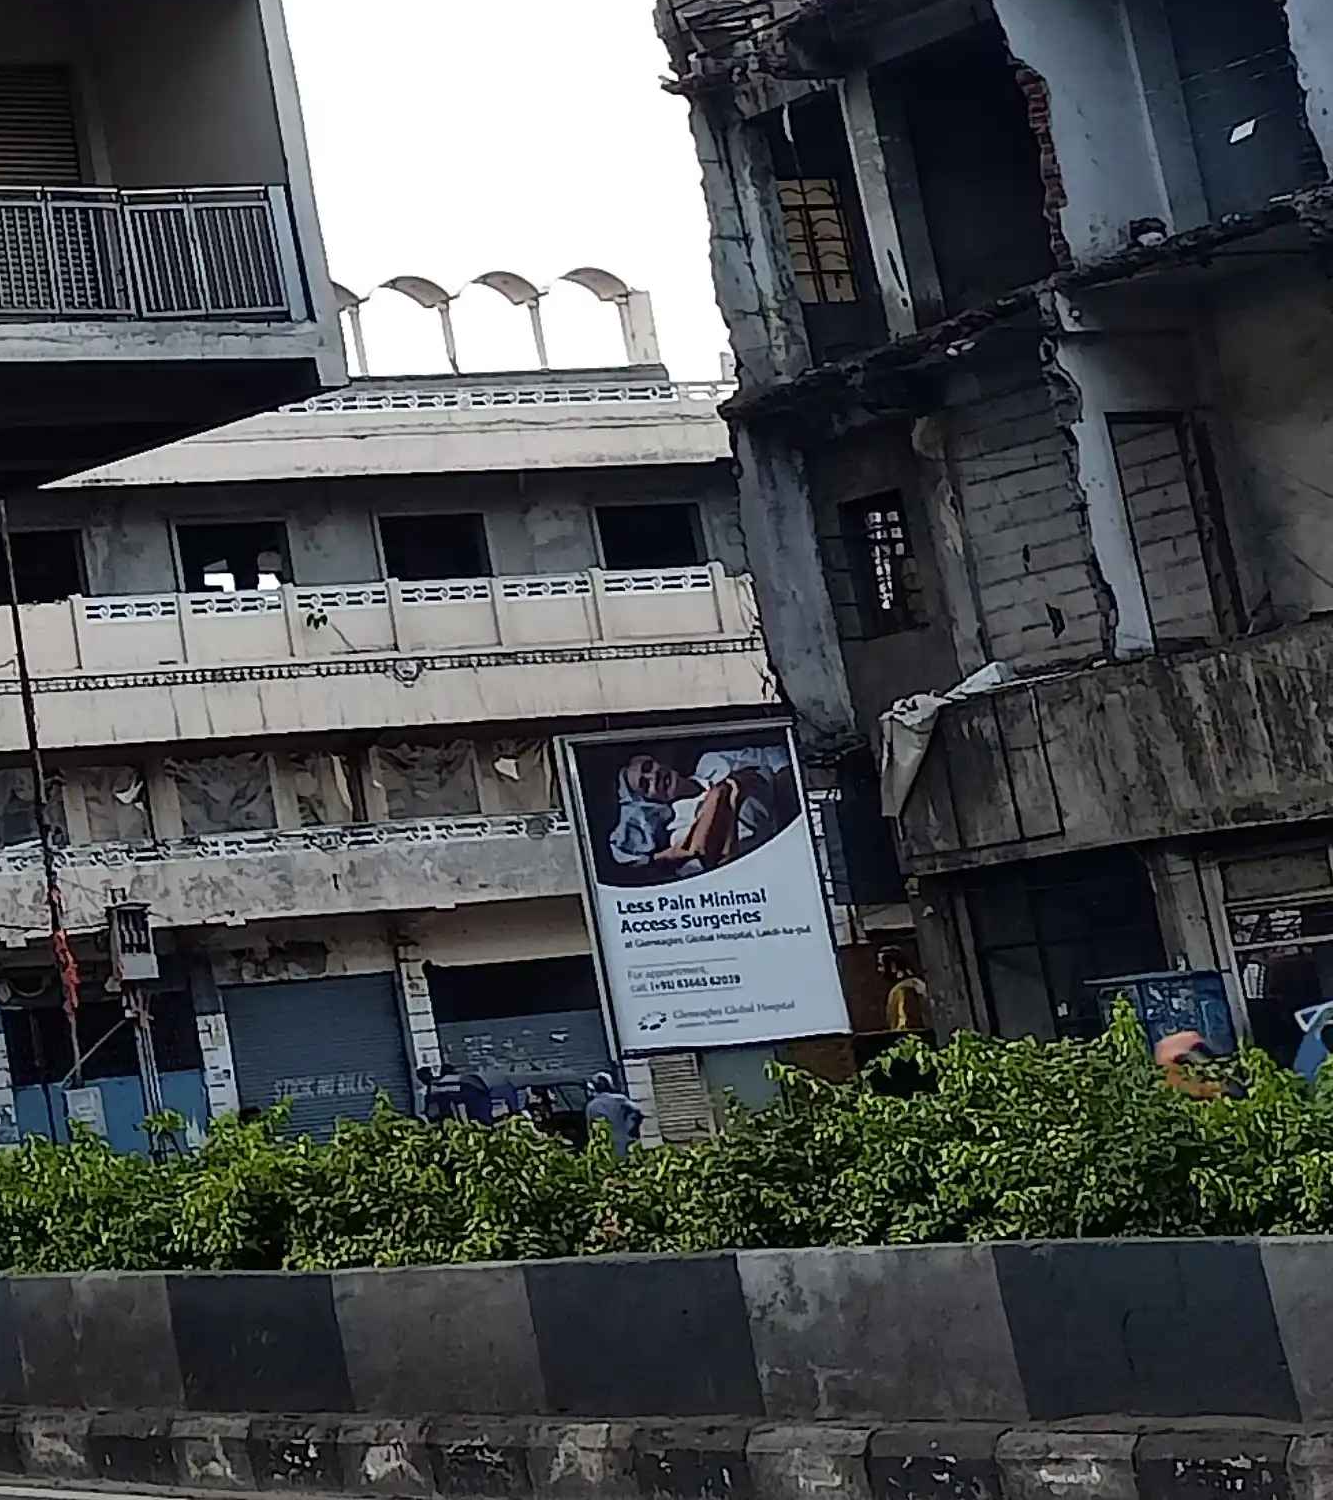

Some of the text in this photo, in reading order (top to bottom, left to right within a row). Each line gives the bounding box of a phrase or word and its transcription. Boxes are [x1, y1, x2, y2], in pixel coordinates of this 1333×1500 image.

[617, 888, 767, 914] Less Pain Minimal
[620, 909, 762, 934] Access Surgeries
